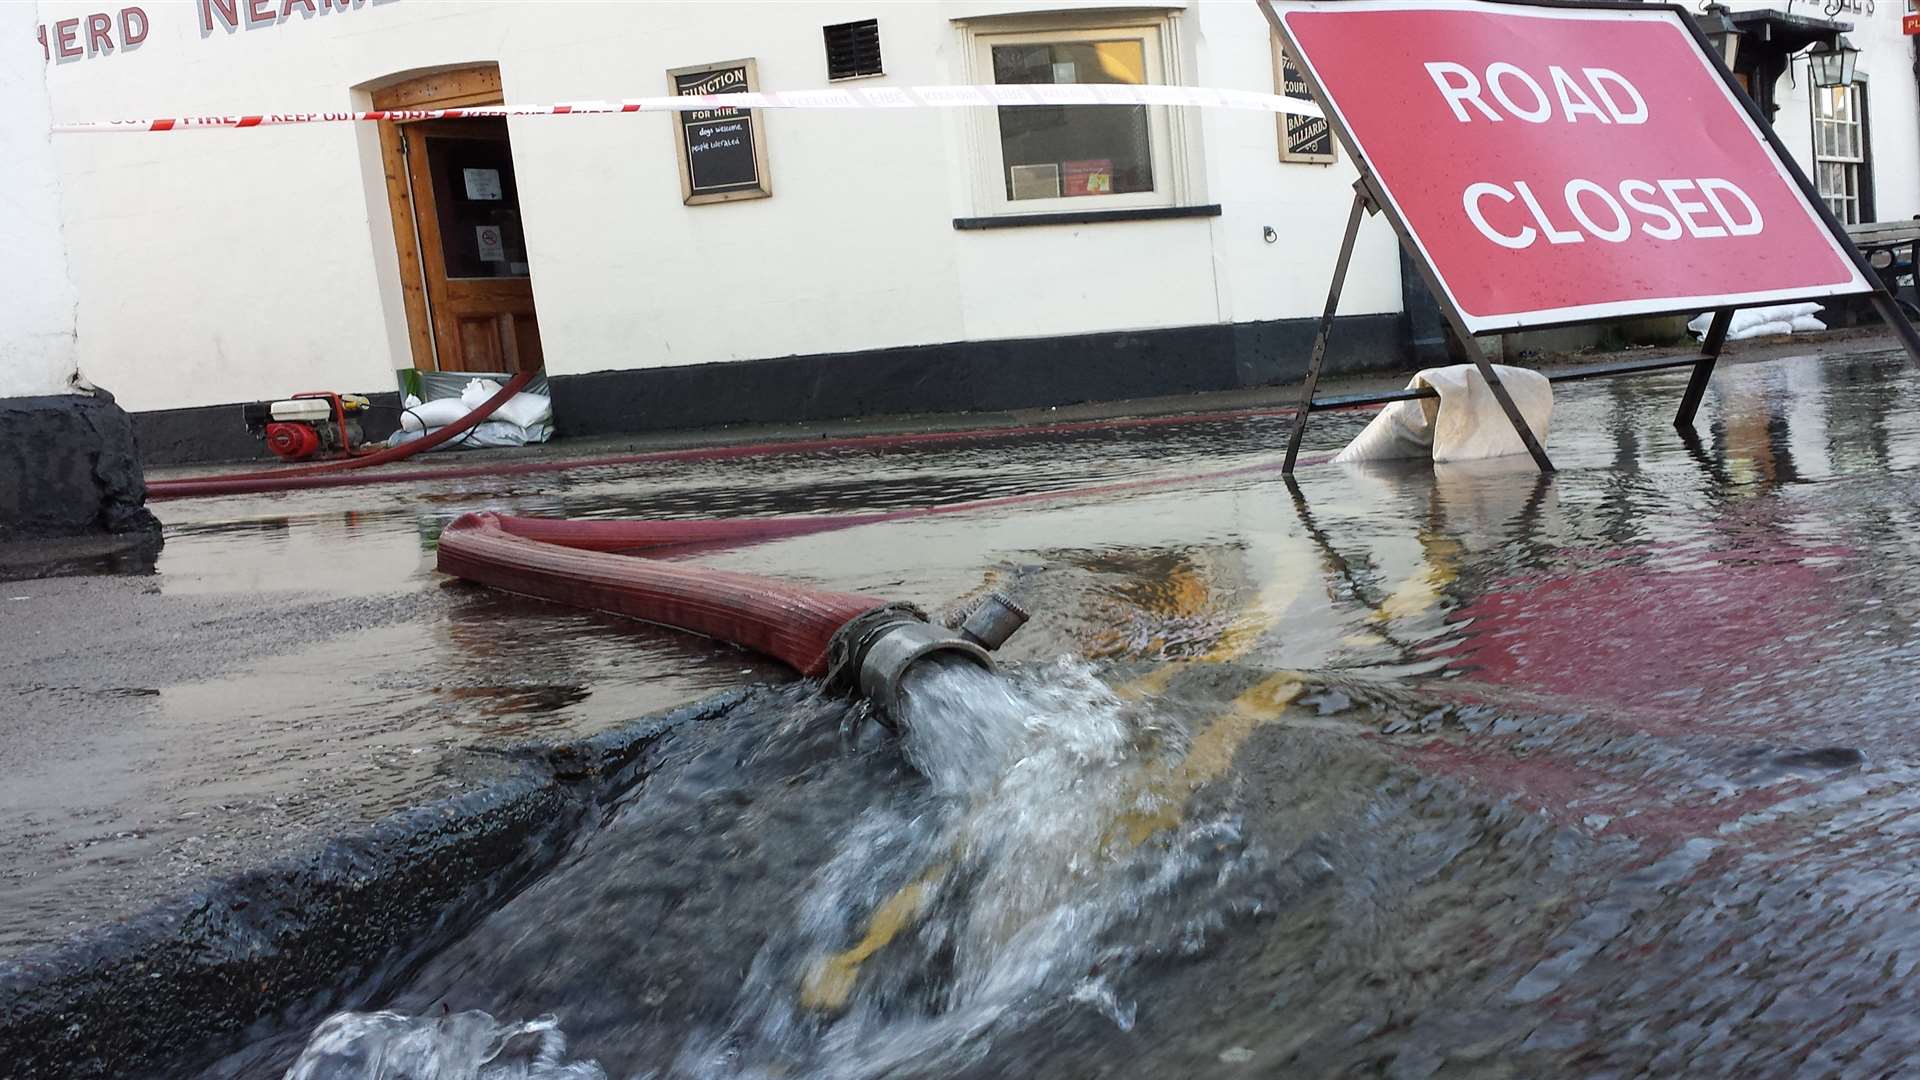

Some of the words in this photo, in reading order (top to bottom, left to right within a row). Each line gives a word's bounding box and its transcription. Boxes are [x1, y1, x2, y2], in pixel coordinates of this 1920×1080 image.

[1908, 19, 1920, 29] PL
[682, 69, 744, 96] FUNCTION
[1423, 61, 1649, 125] ROAD
[692, 110, 711, 120] FOR
[714, 107, 739, 118] HIRE
[699, 127, 714, 137] dogs
[1288, 118, 1328, 149] BILLIARDS
[1462, 177, 1764, 249] CLOSED
